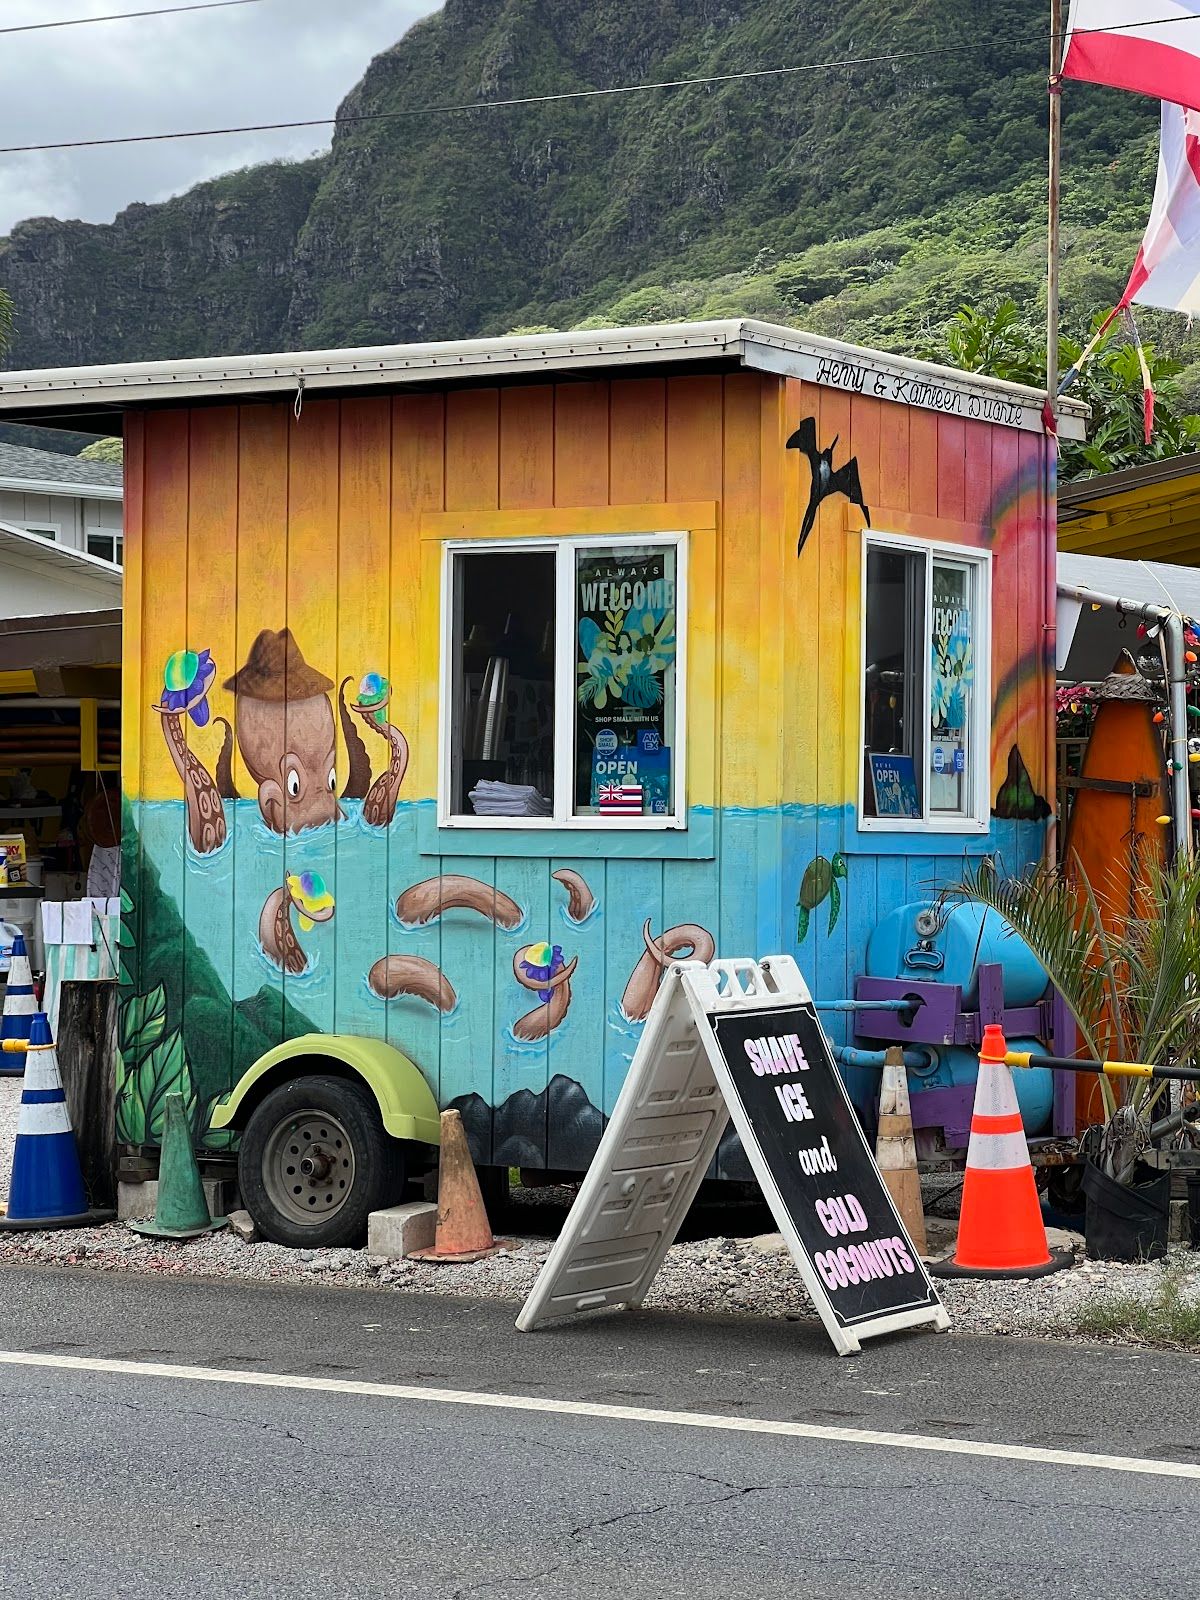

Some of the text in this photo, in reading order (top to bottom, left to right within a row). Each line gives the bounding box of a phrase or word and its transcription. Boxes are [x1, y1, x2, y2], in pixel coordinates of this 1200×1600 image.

[817, 358, 1022, 425] Henry & Kathleen Duarte
[595, 566, 660, 577] ALWAYS
[580, 580, 674, 612] WELCOME
[595, 761, 638, 775] OPEN
[876, 769, 900, 783] OPEN
[743, 1033, 810, 1077] SHAVE
[774, 1083, 814, 1122] ICE
[798, 1135, 838, 1176] and
[815, 1193, 868, 1238] COLD
[814, 1236, 916, 1291] COCONUTS
